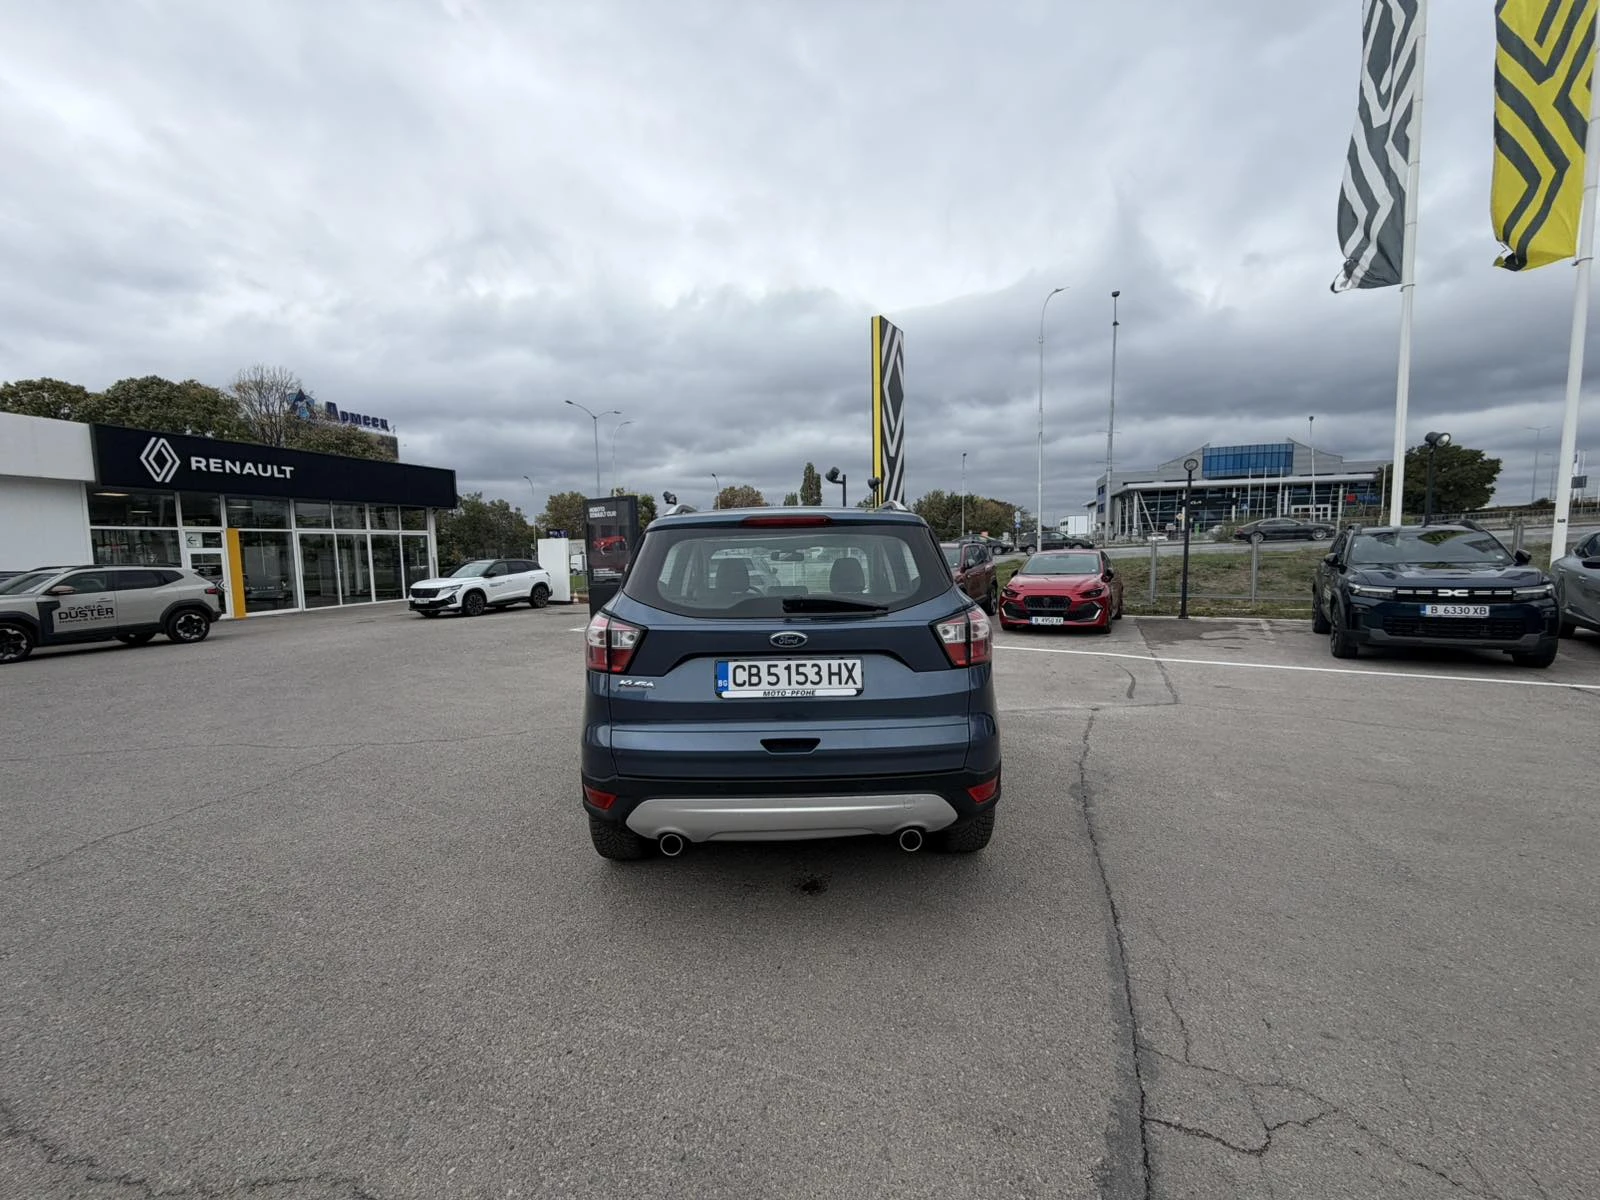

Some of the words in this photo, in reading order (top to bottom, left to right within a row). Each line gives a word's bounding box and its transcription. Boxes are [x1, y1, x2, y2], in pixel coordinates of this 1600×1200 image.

[190, 456, 294, 479] RENAULT
[58, 607, 114, 620] DUSTER
[1430, 606, 1438, 614] B
[1443, 606, 1470, 615] 6330
[1472, 606, 1487, 616] XB
[778, 634, 799, 645] Ford
[732, 664, 762, 688] CB
[767, 663, 823, 687] 5153
[827, 662, 858, 686] HX
[717, 679, 728, 688] BG
